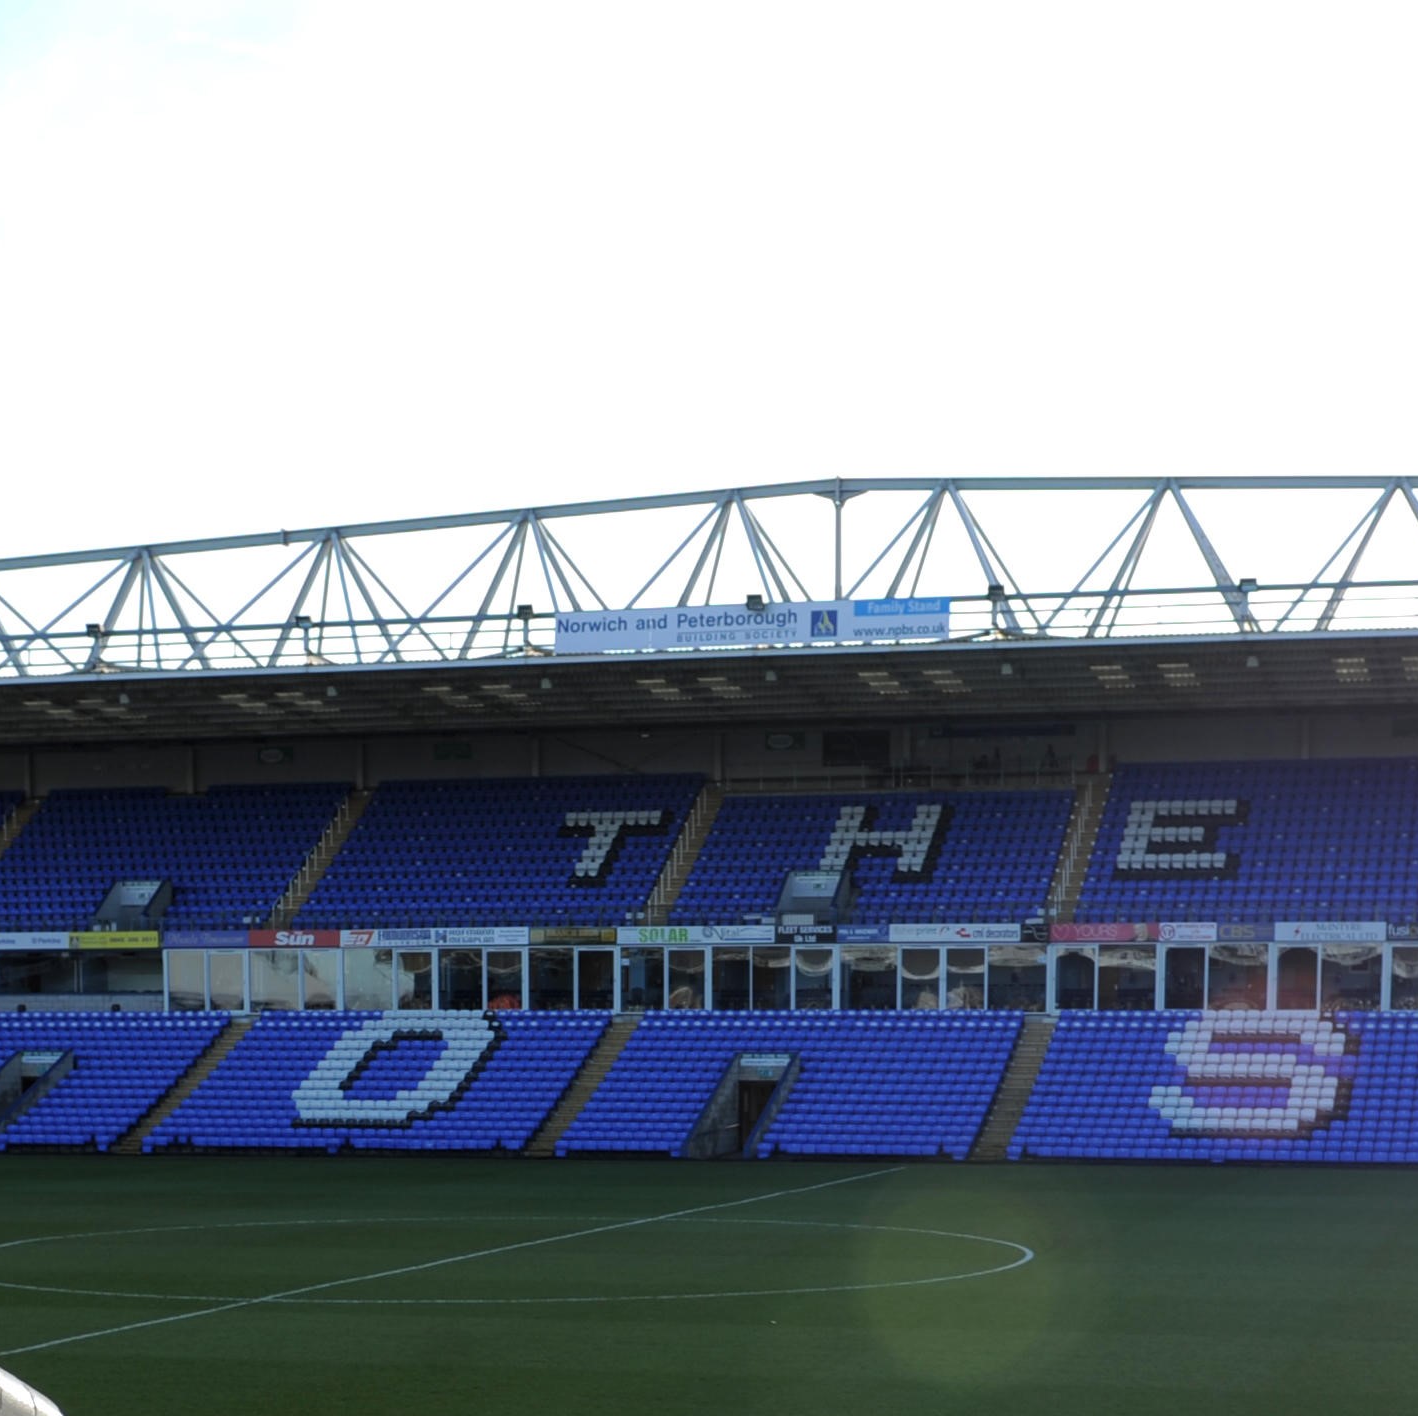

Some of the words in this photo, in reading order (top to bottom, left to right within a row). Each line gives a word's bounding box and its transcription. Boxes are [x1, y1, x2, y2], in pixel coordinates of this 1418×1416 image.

[867, 601, 906, 615] Family
[909, 599, 942, 612] Stand
[557, 616, 627, 637] Norwich
[636, 615, 668, 631] and
[677, 609, 799, 630] Peterborough
[677, 632, 737, 643] BUILDING
[744, 629, 798, 640] SOCIETY
[853, 624, 946, 638] www.npbs.co.uk
[639, 928, 689, 943] SOLAR
[1073, 924, 1118, 937] YOURS
[1219, 925, 1254, 938] CBS
[275, 931, 315, 946] Sun
